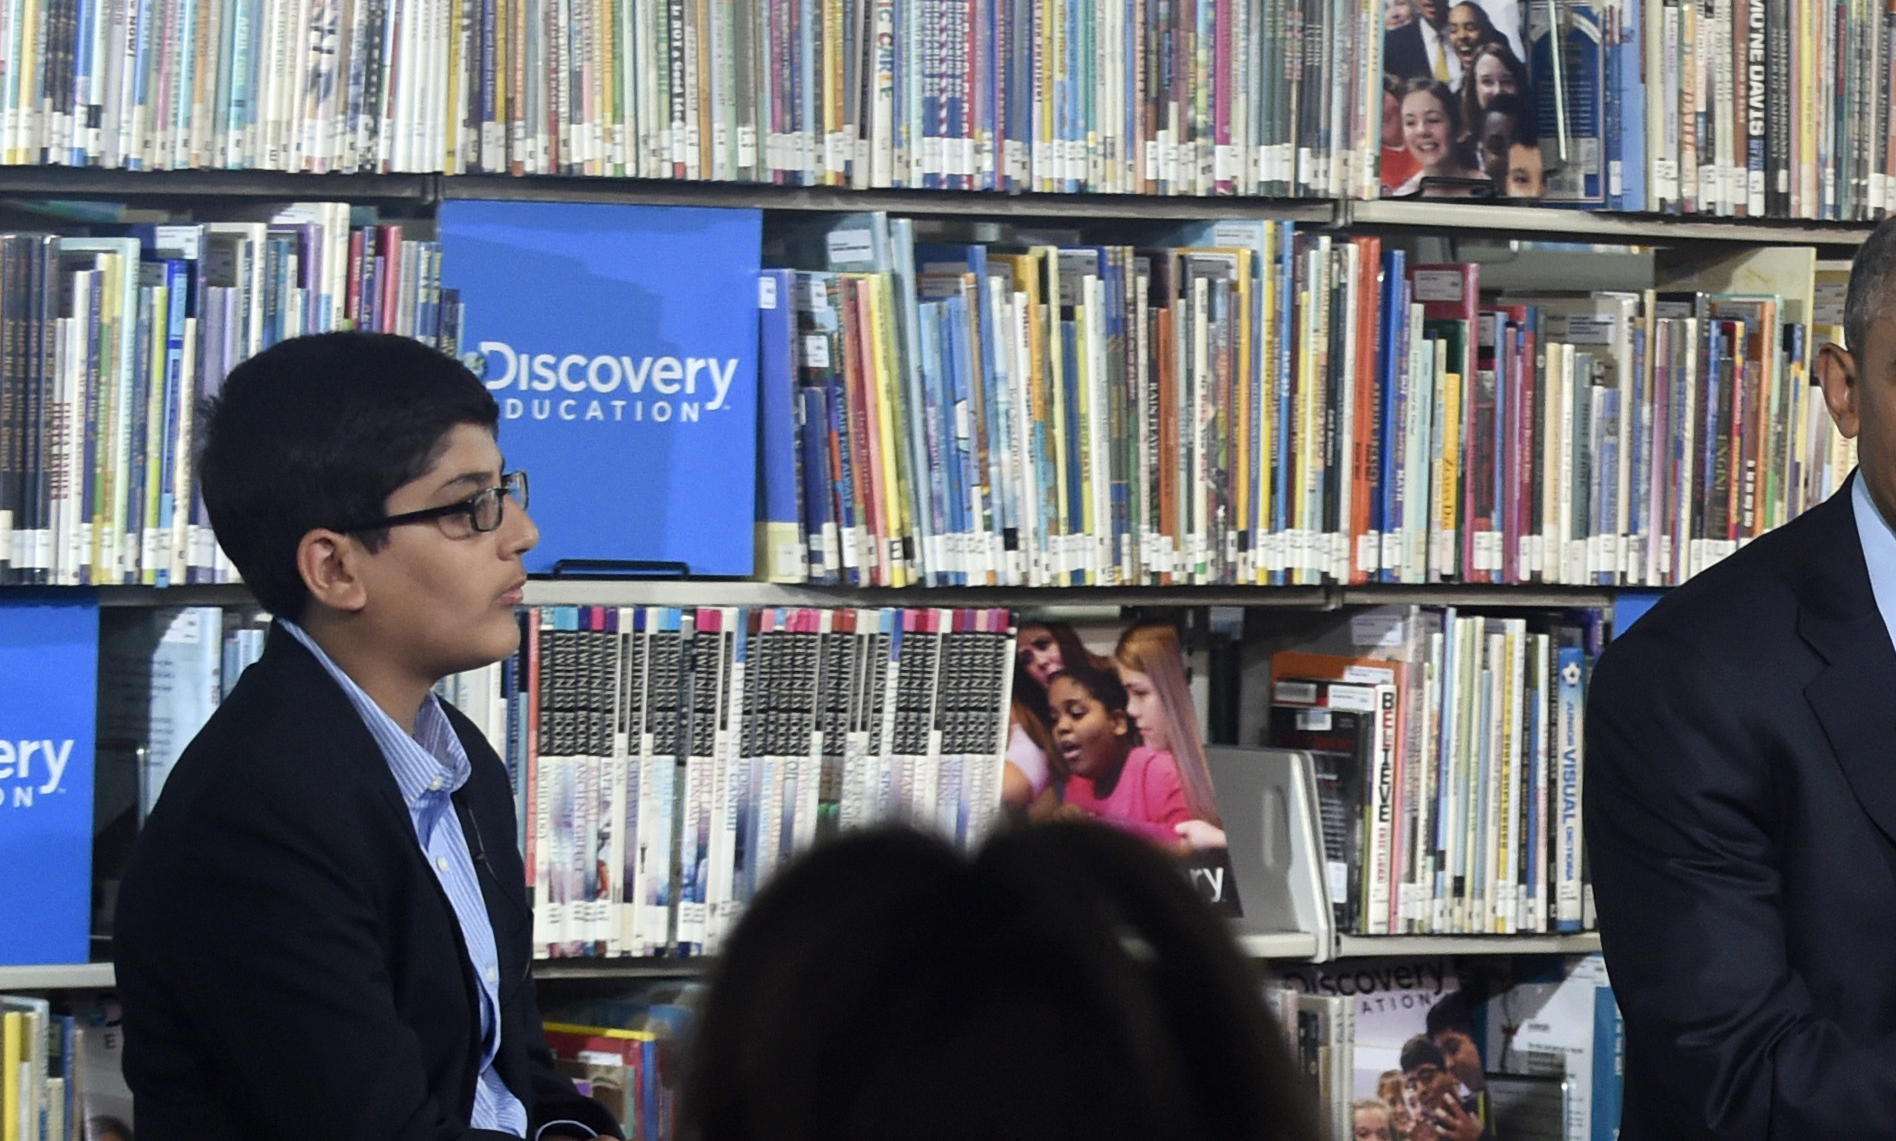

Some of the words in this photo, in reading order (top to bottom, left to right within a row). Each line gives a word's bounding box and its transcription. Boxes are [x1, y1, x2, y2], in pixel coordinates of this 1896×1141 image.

[878, 32, 894, 102] CARLE
[672, 97, 684, 122] Ide
[1749, 65, 1765, 136] DAVIS
[479, 340, 739, 411] Discovery
[504, 398, 700, 423] DUCATION
[837, 398, 847, 434] CHAIR
[1149, 383, 1159, 414] RAIN
[840, 437, 848, 460] FOR
[1149, 418, 1159, 464] PLAYER
[842, 463, 853, 508] ALWAYS
[889, 540, 902, 560] E
[539, 636, 552, 708] EYEWITNESS
[553, 633, 564, 708] EYEWITNESS
[564, 633, 576, 708] EYEWITNESS
[578, 632, 589, 708] EYEWITNESS
[590, 633, 602, 708] EYEWITNESS
[604, 633, 617, 709] EYEWITNESS
[632, 634, 644, 708] EYEWITNESS
[667, 634, 680, 708] EYEWITNESS
[708, 635, 721, 709] EYEWITNESS
[744, 636, 757, 710] EYEWITNESS
[759, 634, 771, 710] EYEWITNESS
[779, 634, 791, 710] EYEWITNESS
[839, 634, 854, 710] EYEWITNESS
[874, 634, 888, 710] EYEWITNESS
[538, 711, 550, 753] BOOKS
[552, 712, 564, 755] BOOKS
[562, 712, 575, 755] BOOKS
[575, 712, 588, 754] BOOKS
[588, 711, 601, 755] BOOKS
[603, 713, 616, 757] BOOKS
[630, 711, 643, 755] BOOKS
[665, 712, 679, 755] BOOKS
[704, 712, 718, 755] BOOKS
[741, 713, 755, 757] BOOKS
[754, 714, 768, 756] BOOKS
[776, 714, 788, 755] BOOKS
[837, 714, 850, 755] BOOKS
[868, 714, 882, 756] BOOKS
[1565, 701, 1574, 747] JUNIOR
[1562, 748, 1577, 825] VISUAL
[1565, 826, 1574, 881] DICTIONA
[1361, 993, 1433, 1015] ATION
